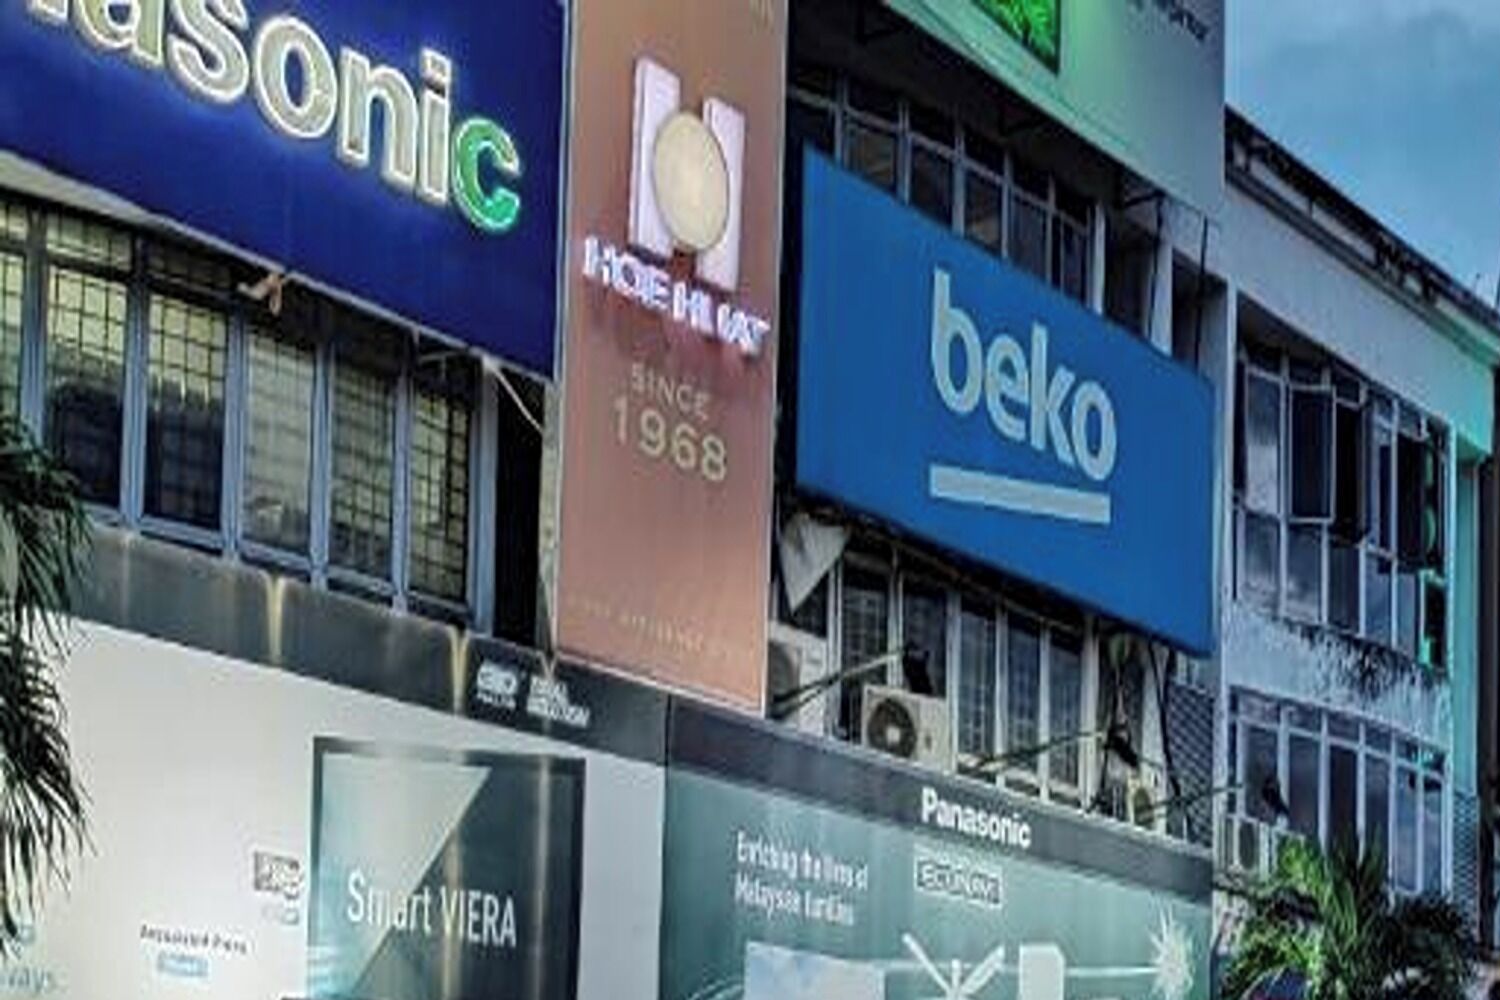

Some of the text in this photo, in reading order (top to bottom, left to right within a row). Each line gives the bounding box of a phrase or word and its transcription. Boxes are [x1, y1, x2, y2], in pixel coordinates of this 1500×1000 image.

[28, 0, 521, 232] asonic
[631, 363, 711, 421] SINCE
[930, 266, 1117, 482] beko
[612, 398, 727, 482] 1968
[921, 785, 1032, 849] Panasonic
[347, 870, 432, 932] Smart
[440, 885, 517, 948] VIERA
